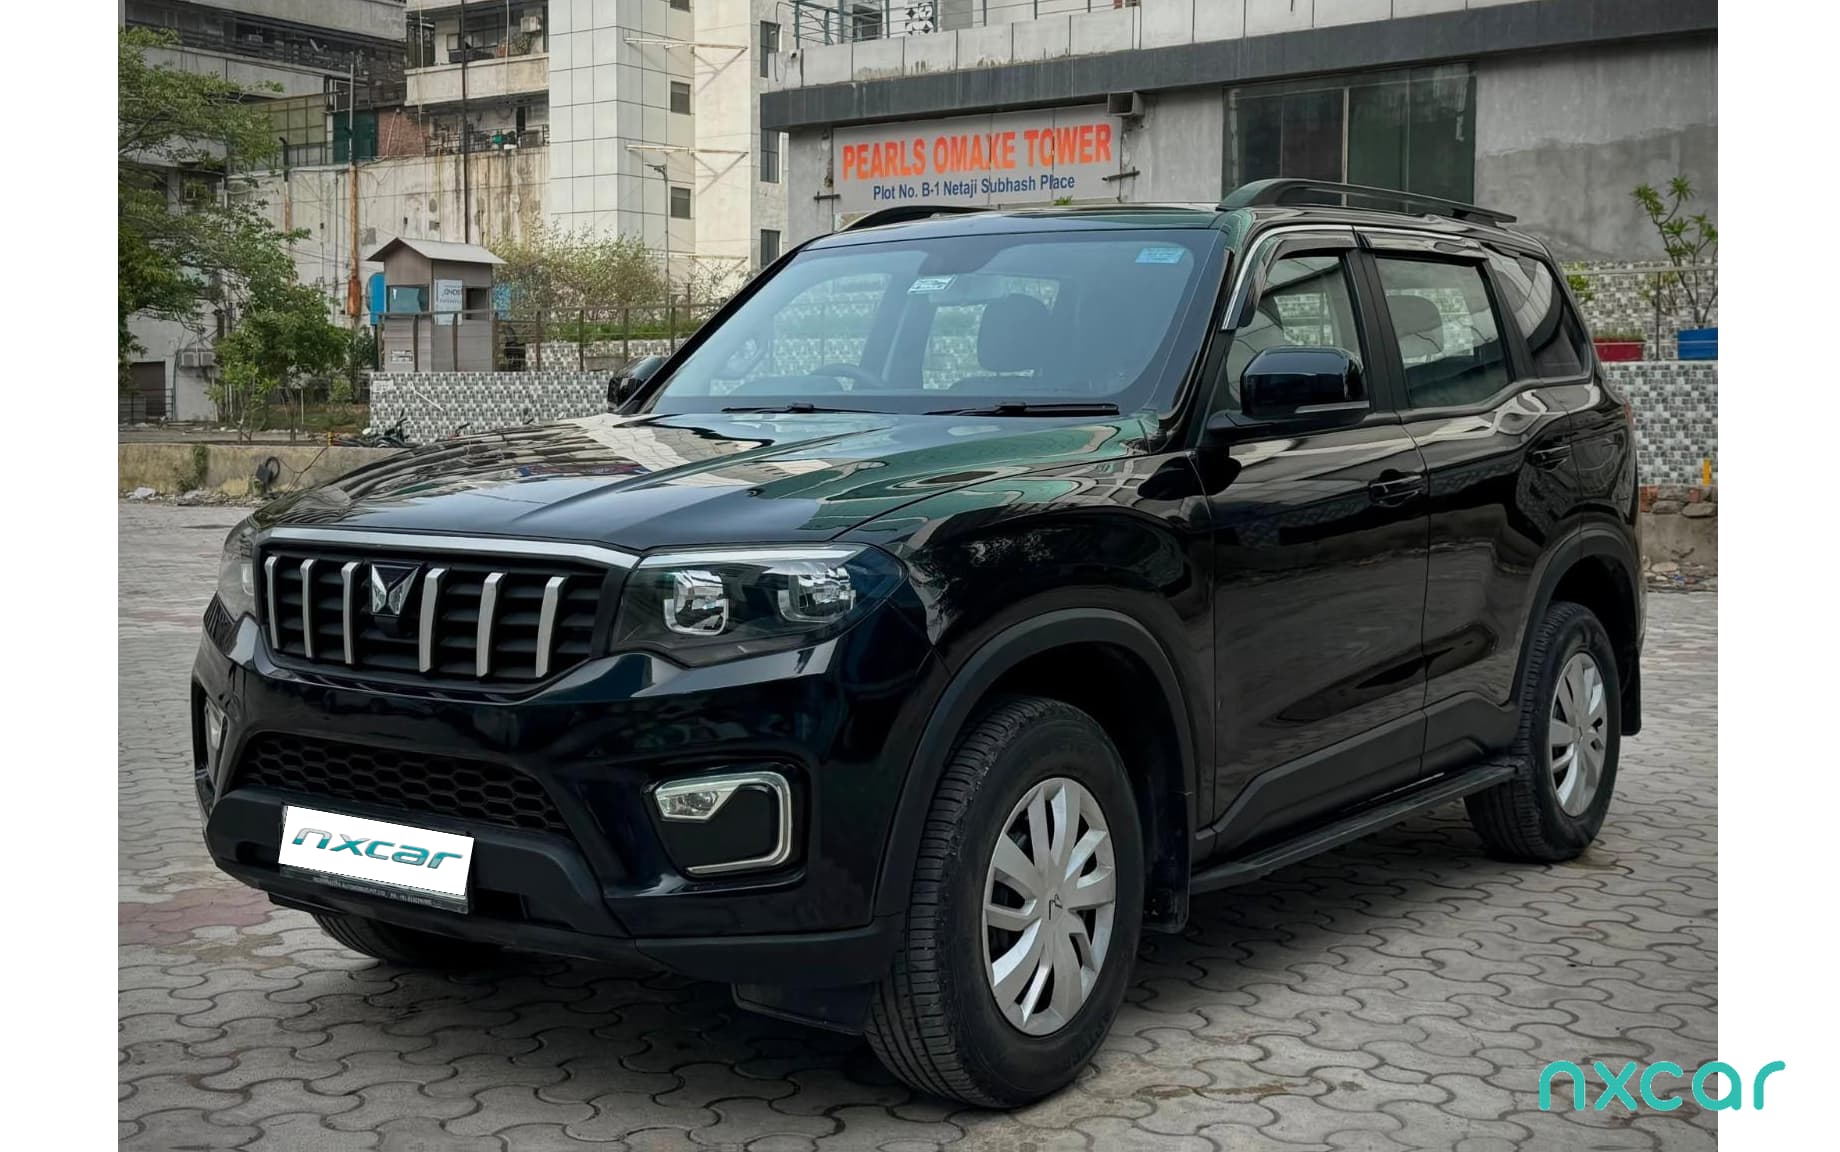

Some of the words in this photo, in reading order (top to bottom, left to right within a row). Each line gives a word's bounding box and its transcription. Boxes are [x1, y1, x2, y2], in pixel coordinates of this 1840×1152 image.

[842, 138, 926, 181] PEARLS
[932, 131, 1016, 174] OMAXE
[1023, 123, 1112, 168] TOWER
[873, 184, 895, 201] Plot
[898, 183, 918, 200] No.
[921, 181, 940, 198] B-1
[943, 177, 977, 198] Netaji
[981, 175, 1036, 194] Subhash
[1040, 174, 1075, 190] Place
